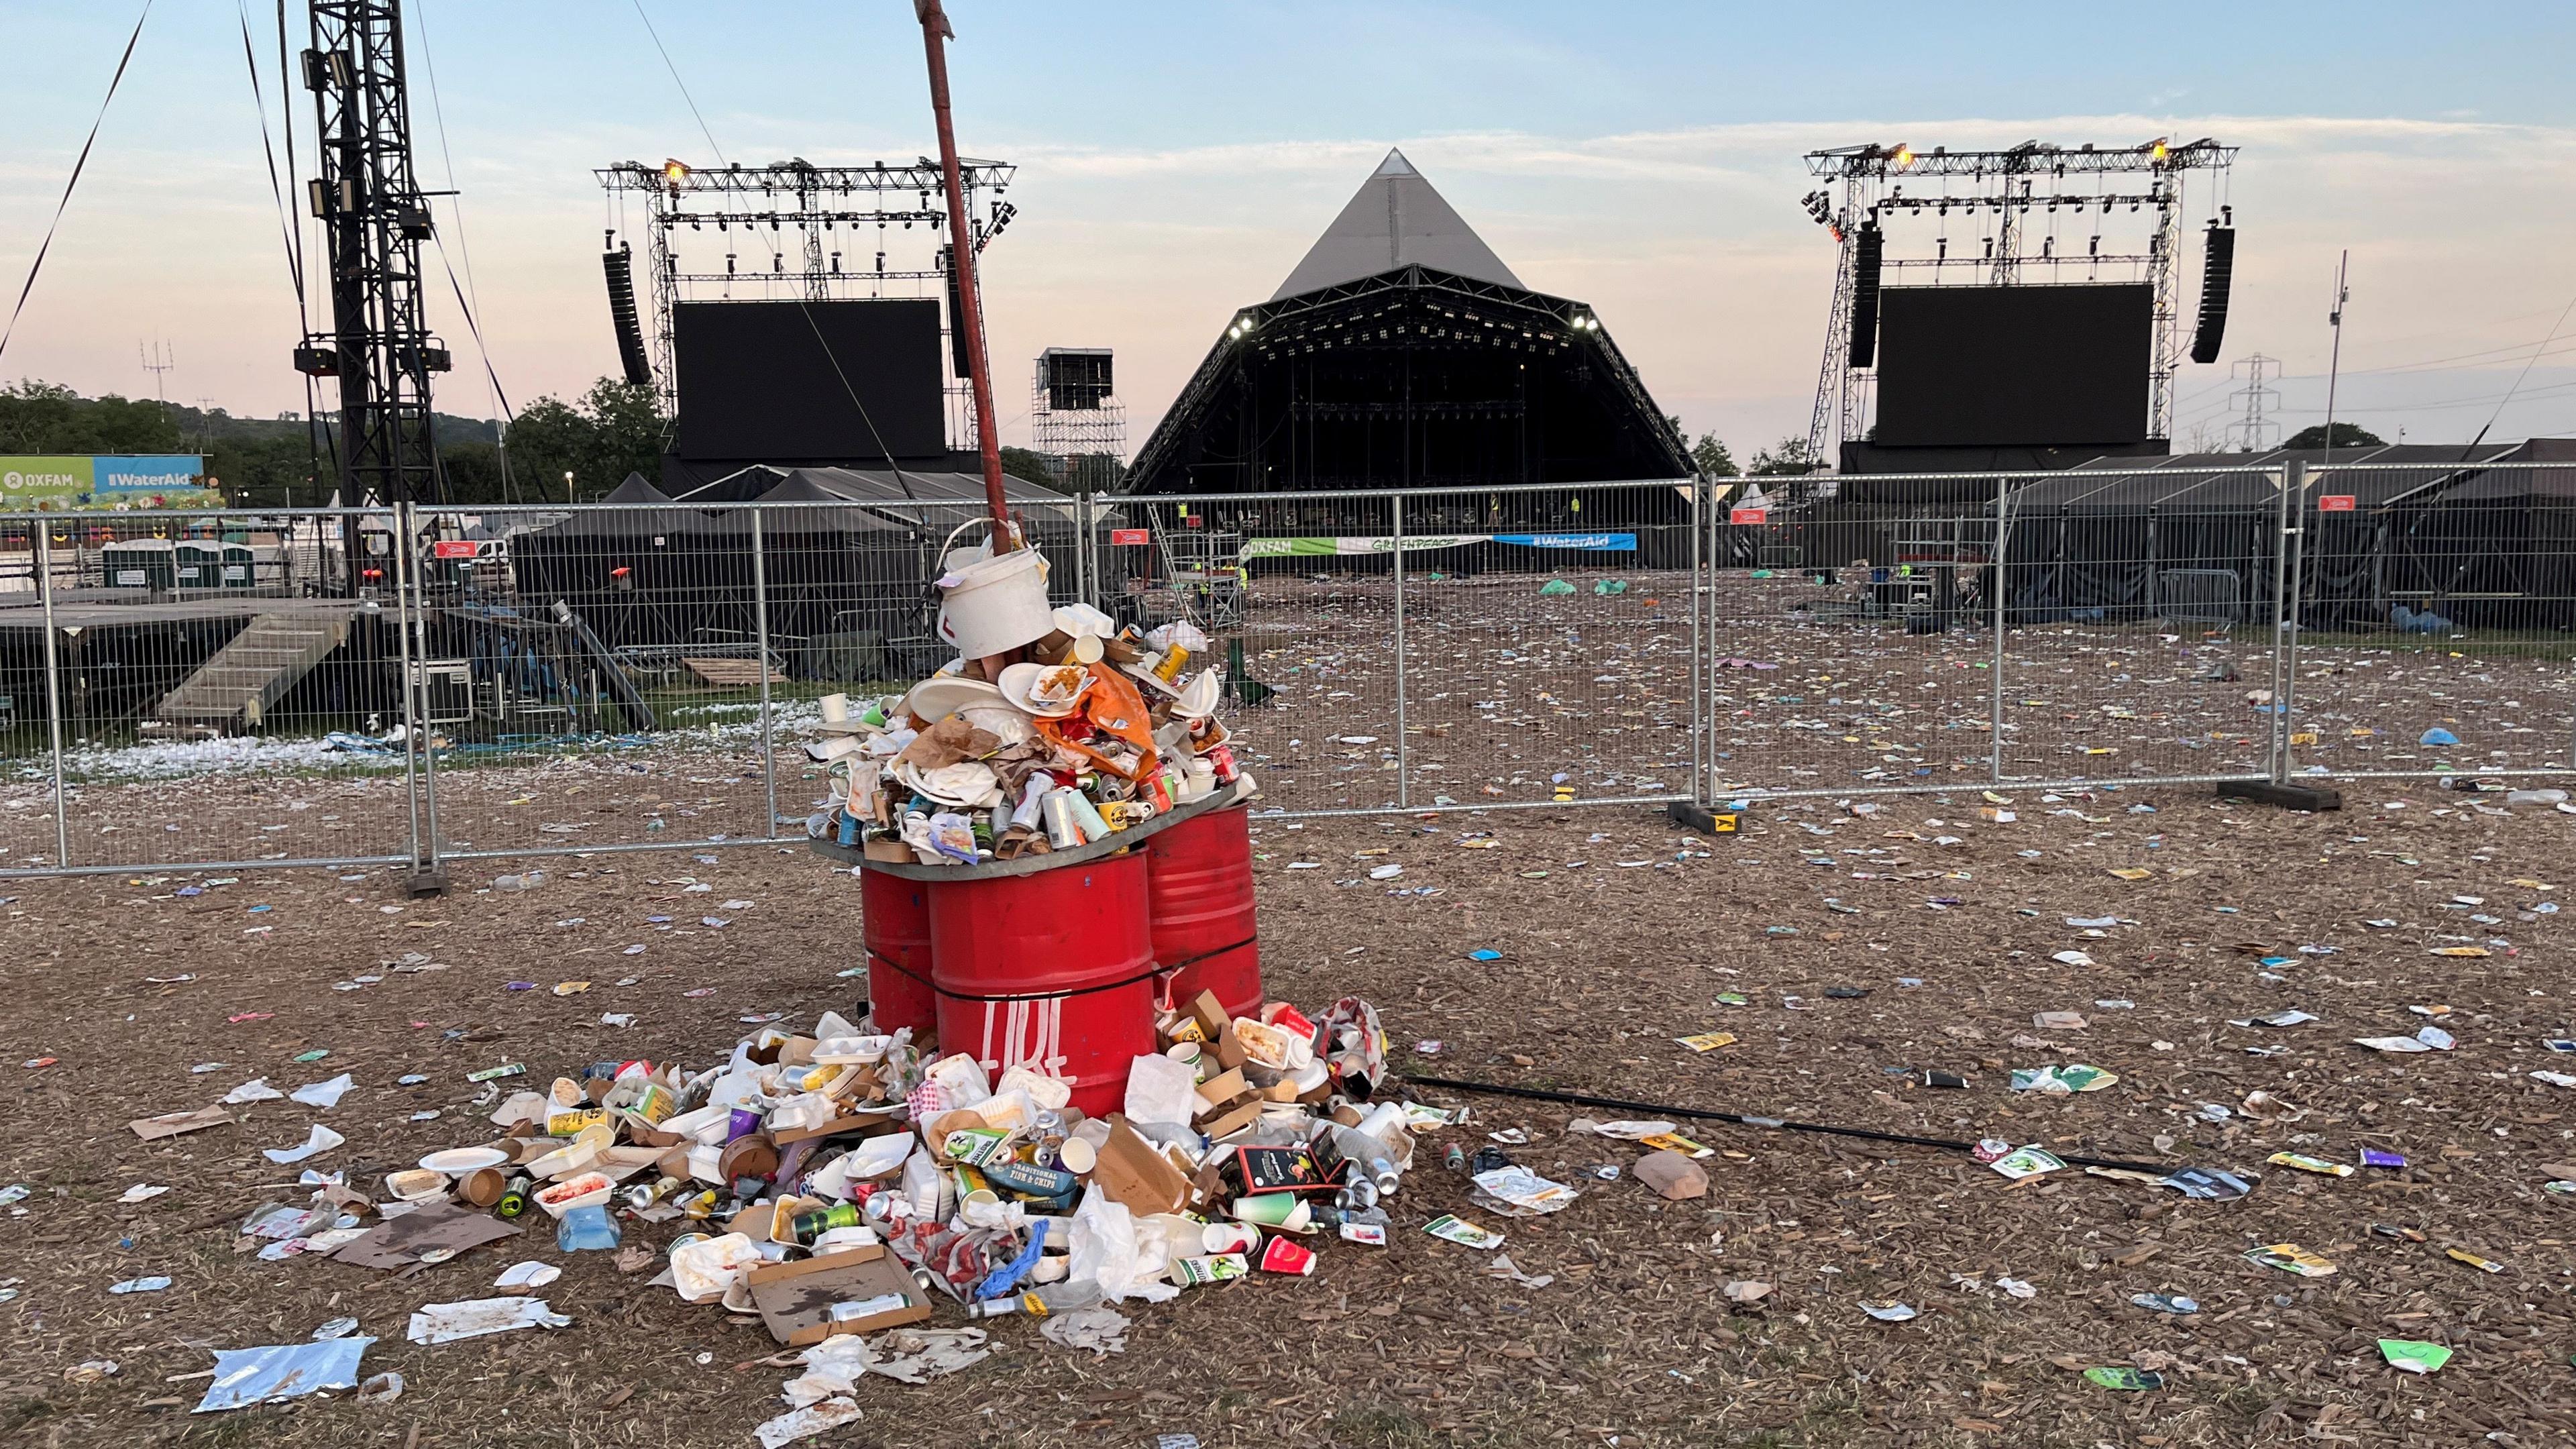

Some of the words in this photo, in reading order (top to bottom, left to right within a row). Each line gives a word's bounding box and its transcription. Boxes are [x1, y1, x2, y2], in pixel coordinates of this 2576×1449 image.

[25, 474, 73, 486] OXFAM
[117, 473, 189, 486] WaterAid
[1250, 541, 1291, 553] OXFAM
[1542, 535, 1609, 547] WaterAid
[1014, 1163, 1057, 1179] TRADITIONAL
[1010, 1170, 1027, 1181] FISH
[1034, 1177, 1055, 1189] CHIPS
